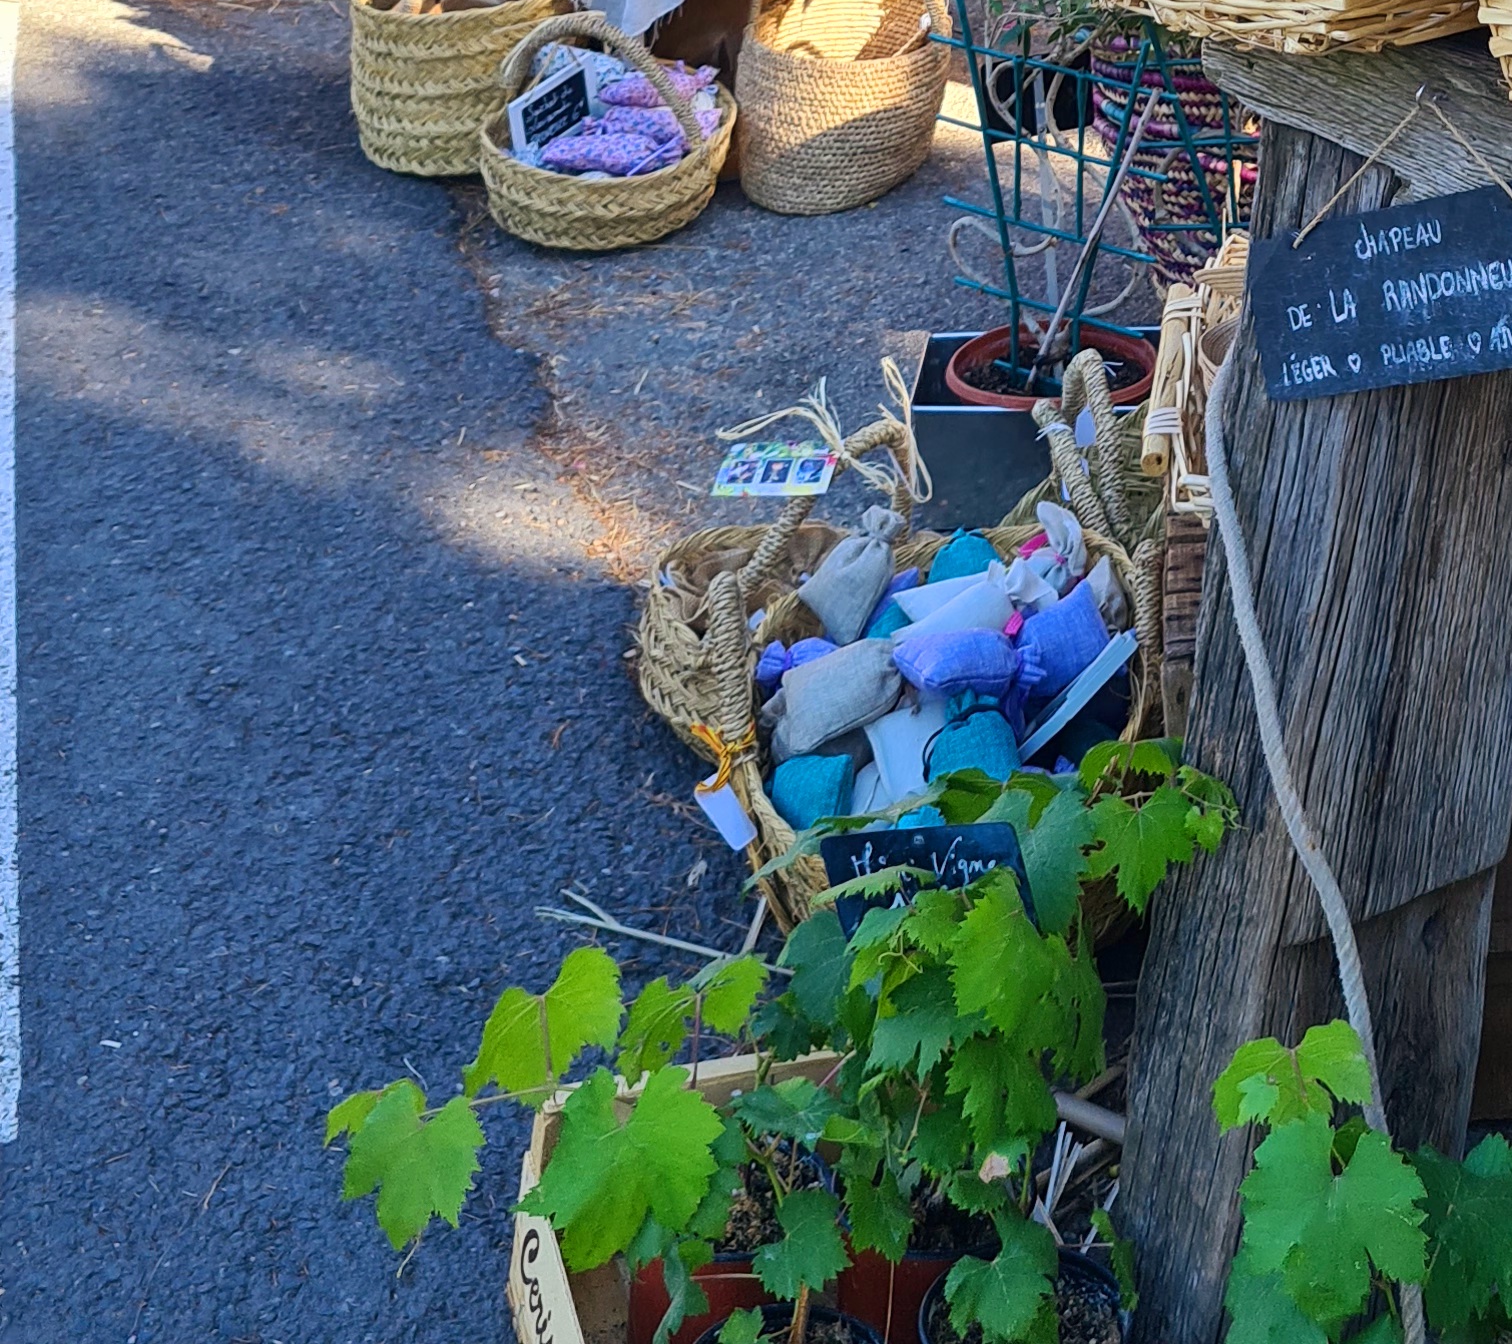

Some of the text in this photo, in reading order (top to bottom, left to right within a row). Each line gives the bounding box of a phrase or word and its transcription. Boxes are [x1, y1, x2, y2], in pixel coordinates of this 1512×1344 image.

[1287, 304, 1313, 331] DE
[1329, 289, 1357, 323] LA
[1381, 335, 1453, 366] PLIABLE
